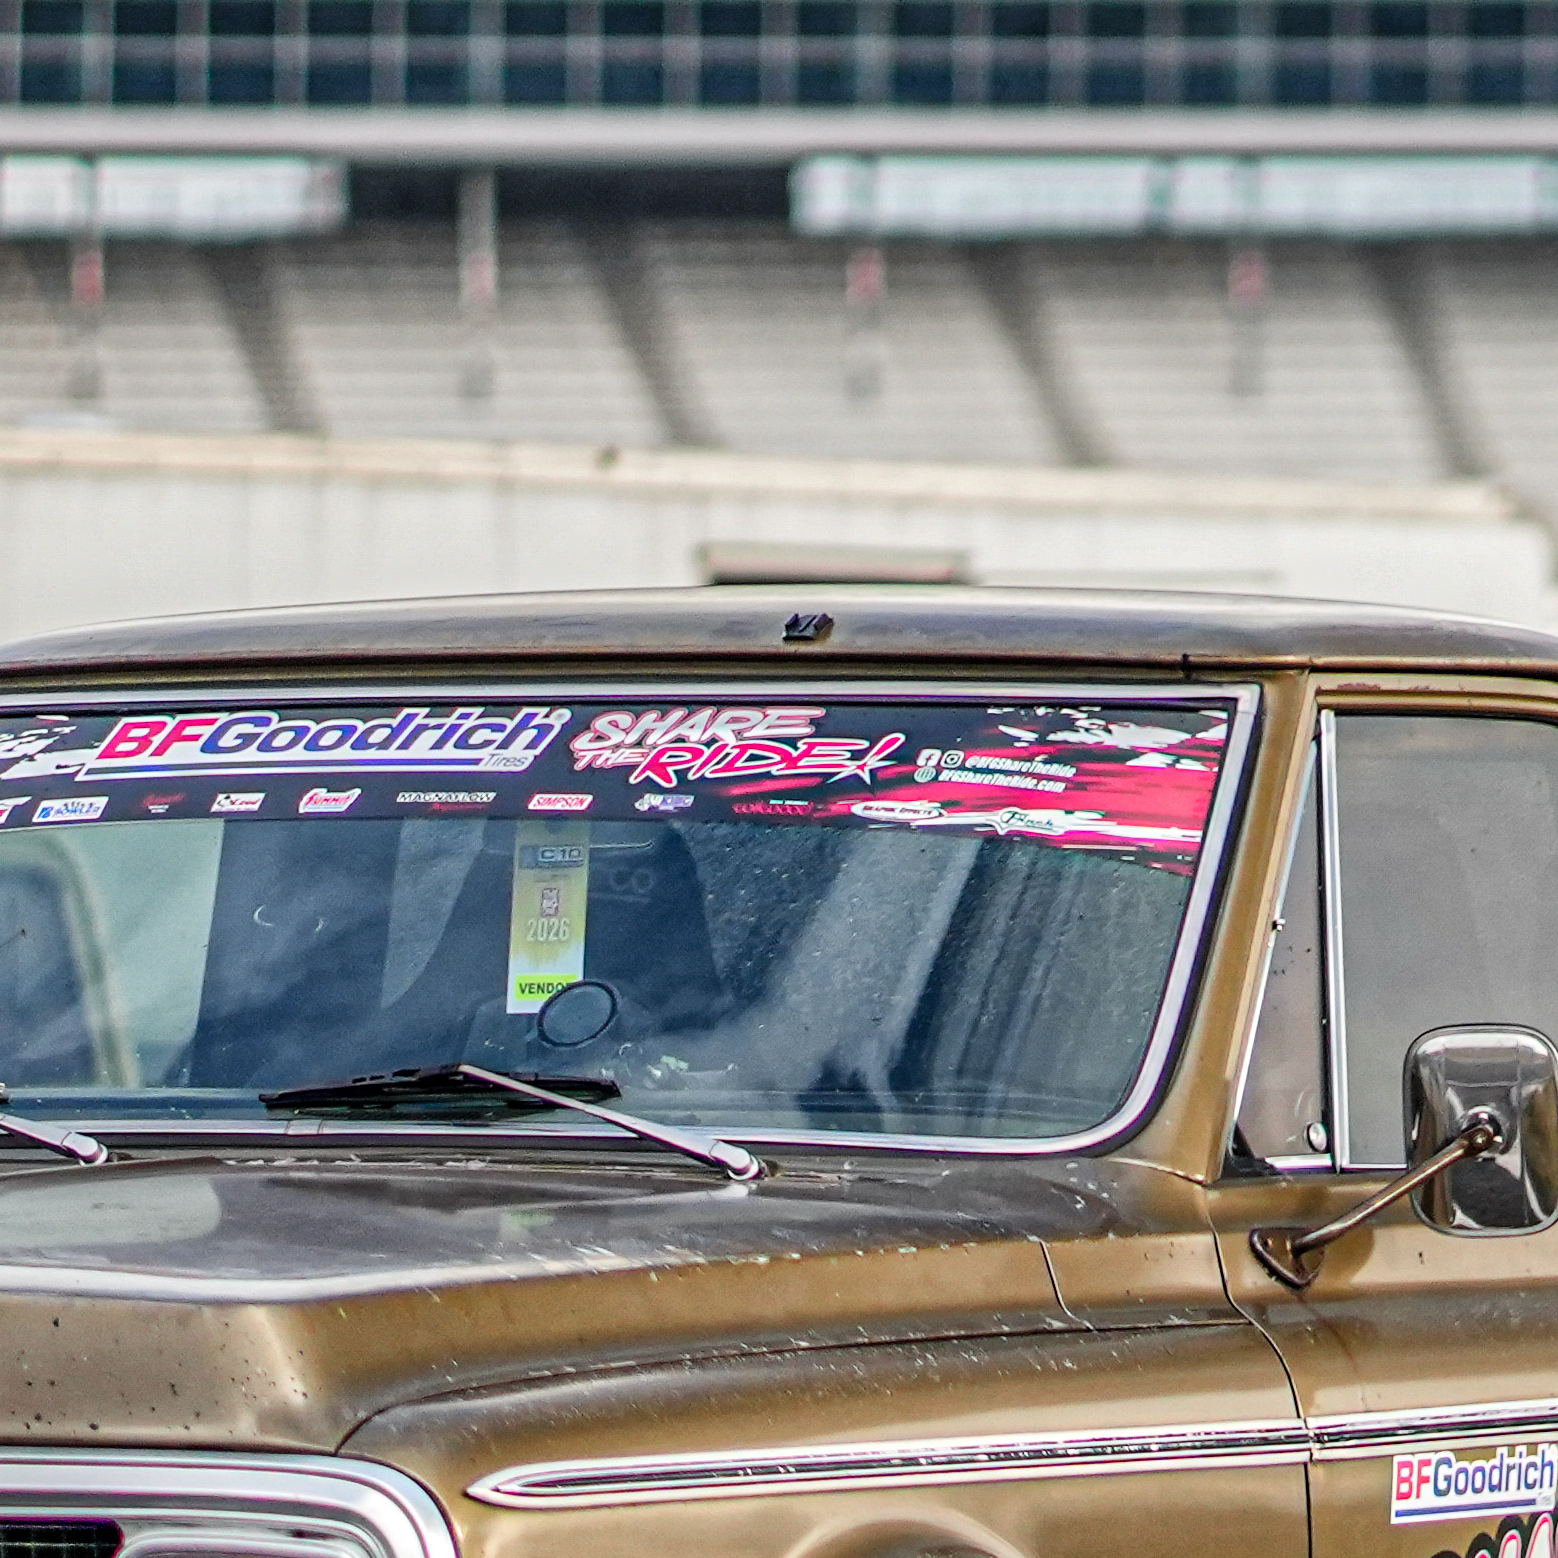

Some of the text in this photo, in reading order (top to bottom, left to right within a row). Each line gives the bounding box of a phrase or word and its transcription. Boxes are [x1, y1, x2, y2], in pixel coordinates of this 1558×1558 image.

[95, 710, 555, 759] BFGoodrich
[571, 705, 827, 752] SHARE
[481, 752, 531, 770] Tires
[573, 731, 906, 788] THE RIDE!
[533, 796, 588, 808] SIMPSON
[527, 917, 571, 941] 2026
[1395, 1449, 1555, 1501] BFGoodrich
